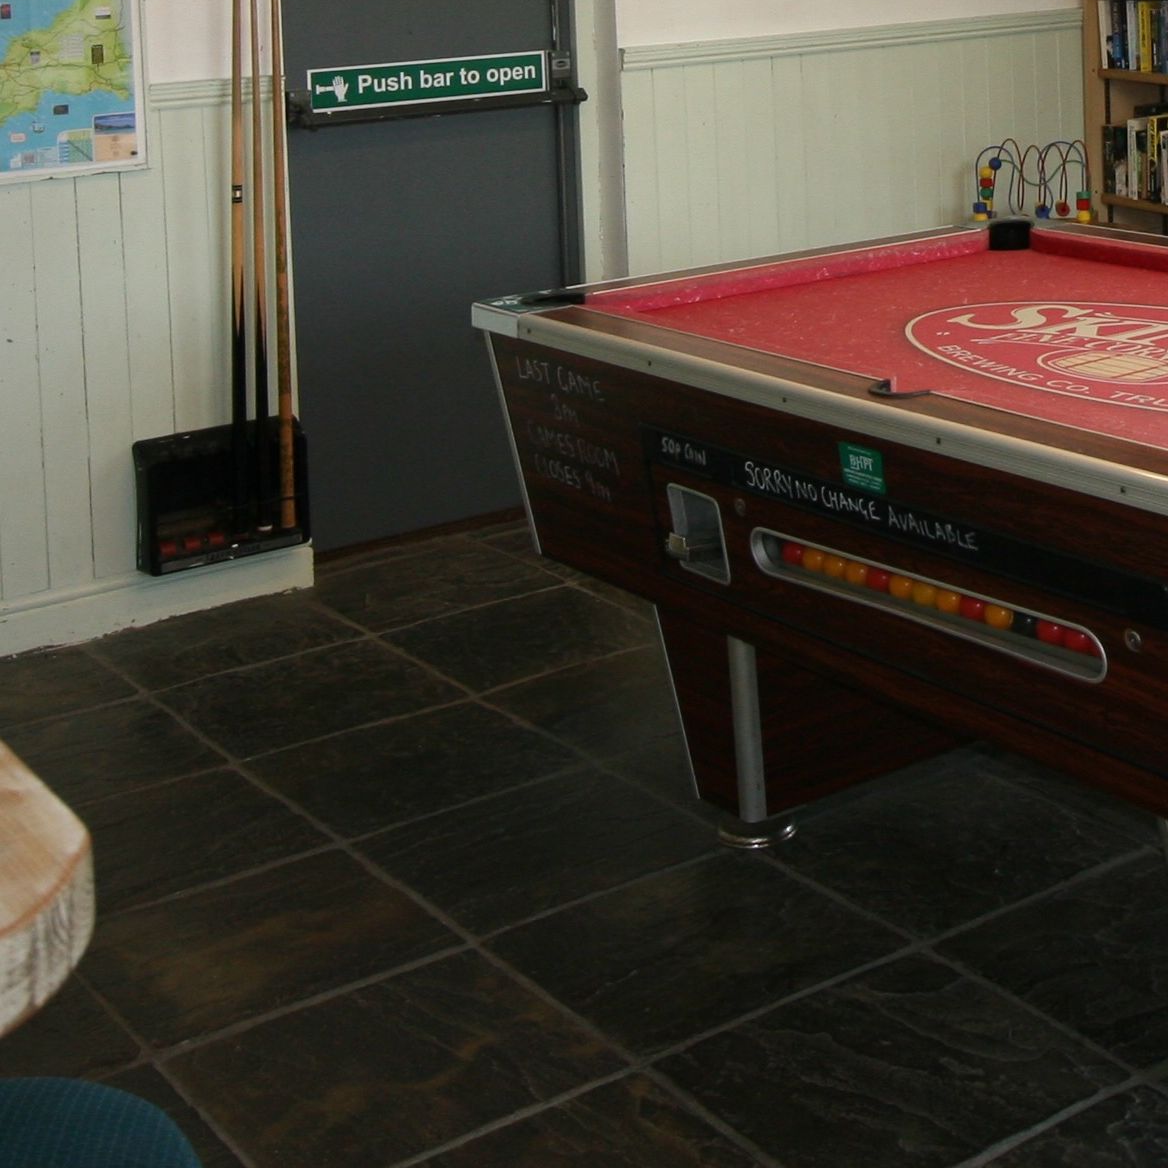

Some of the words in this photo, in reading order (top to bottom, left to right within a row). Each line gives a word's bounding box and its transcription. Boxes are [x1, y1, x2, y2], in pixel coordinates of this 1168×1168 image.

[357, 71, 414, 94] Push
[419, 68, 454, 89] bar
[459, 67, 481, 85] to
[486, 63, 537, 87] open
[515, 356, 550, 385] LAST
[556, 366, 606, 401] GAME
[937, 344, 1044, 382] BREWING
[1046, 379, 1091, 394] CO.
[577, 438, 621, 476] ROOM
[744, 461, 794, 499] SORRY
[794, 479, 818, 502] NO
[821, 485, 881, 521] CHANGE
[887, 504, 979, 551] AVAILABLE
